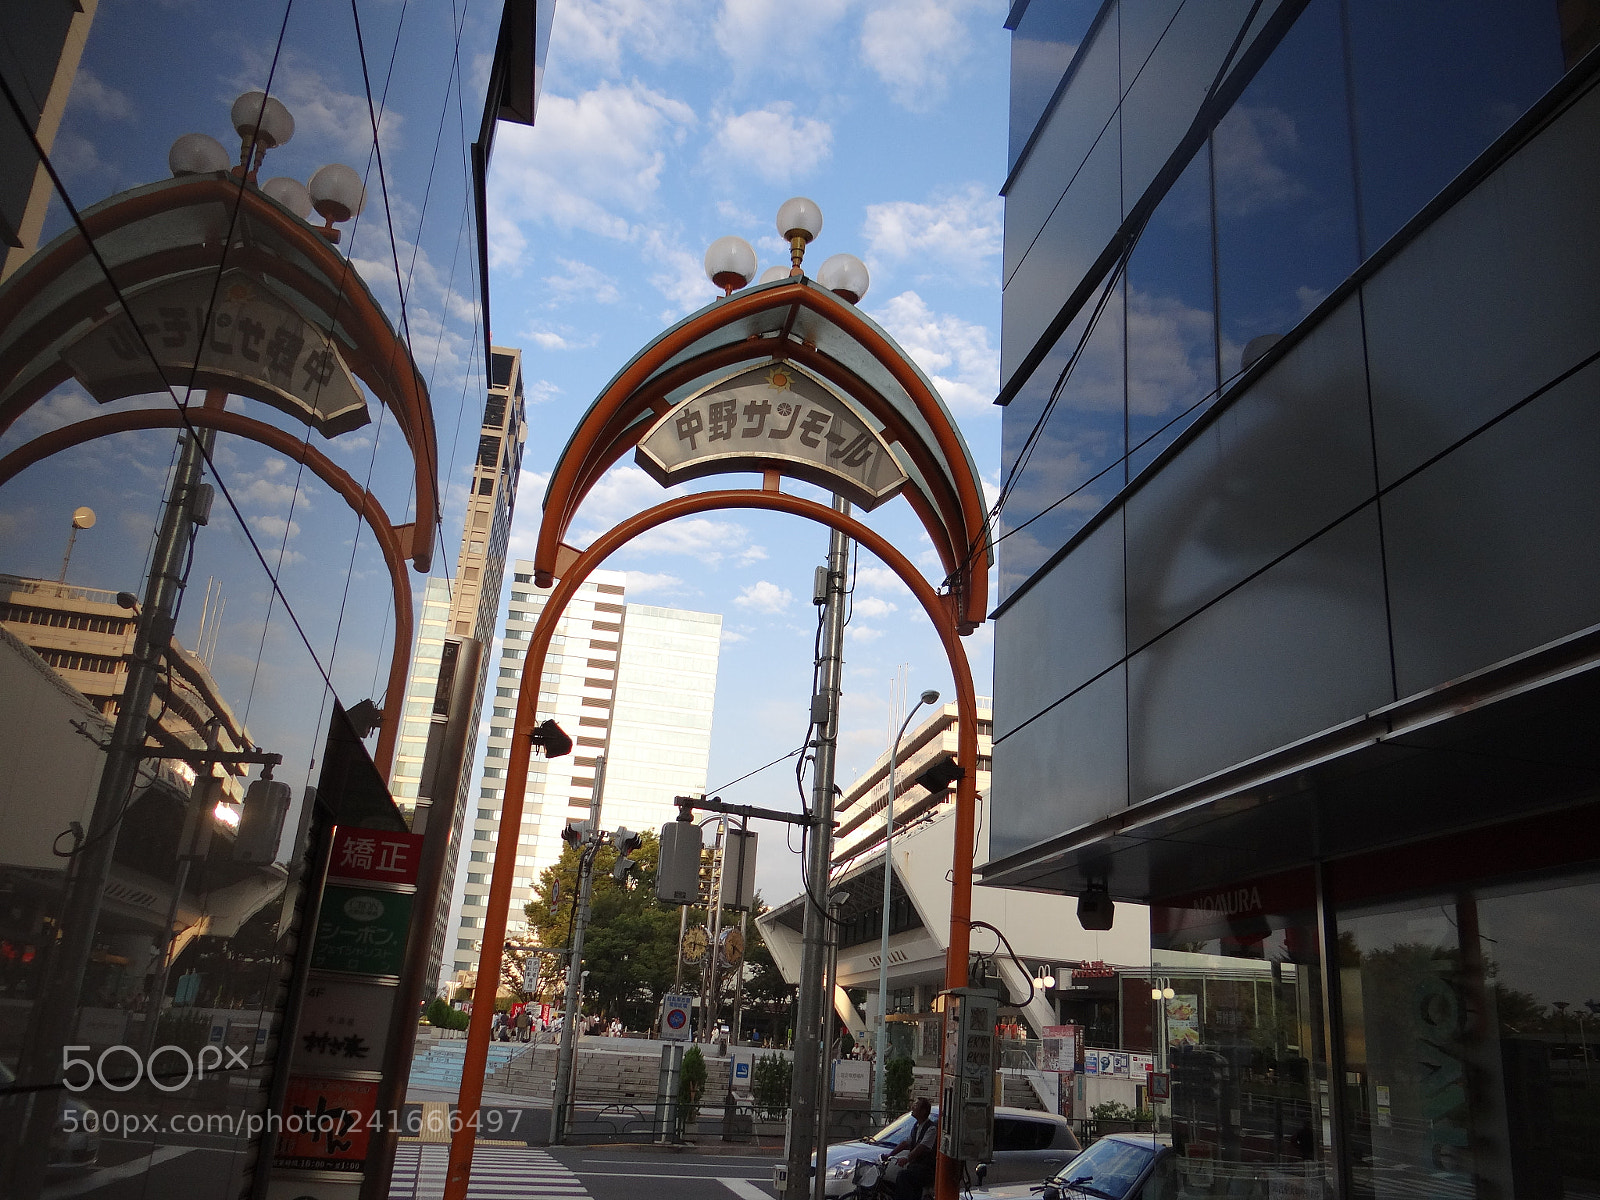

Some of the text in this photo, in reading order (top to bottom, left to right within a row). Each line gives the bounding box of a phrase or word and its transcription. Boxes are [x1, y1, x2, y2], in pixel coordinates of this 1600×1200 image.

[675, 399, 873, 468] 中野サンモール
[340, 836, 411, 873] 矯正
[1193, 886, 1262, 917] NOMURA
